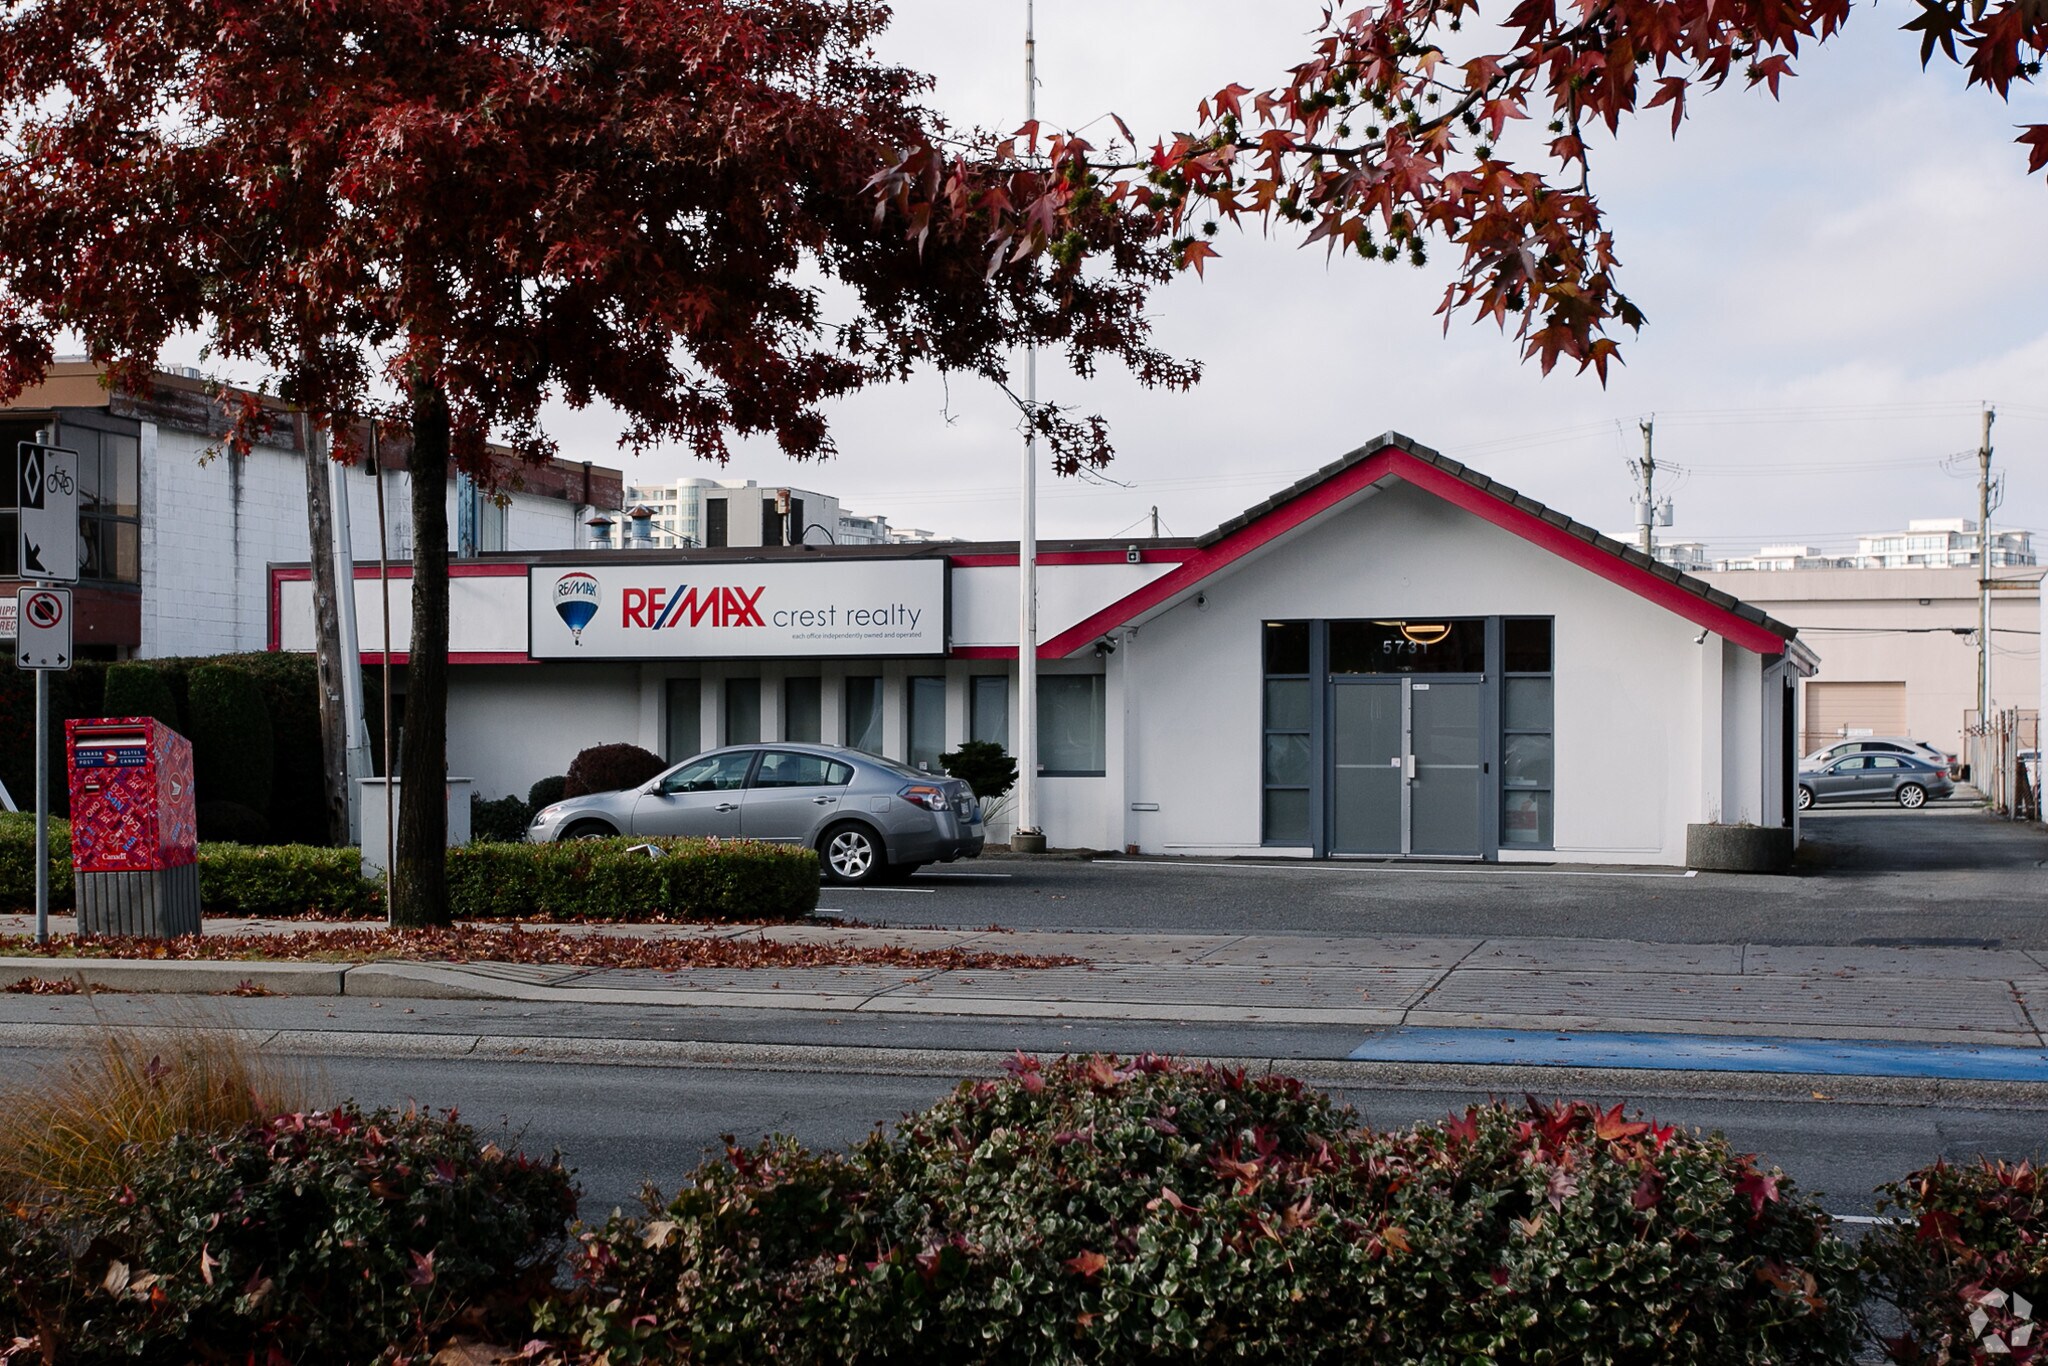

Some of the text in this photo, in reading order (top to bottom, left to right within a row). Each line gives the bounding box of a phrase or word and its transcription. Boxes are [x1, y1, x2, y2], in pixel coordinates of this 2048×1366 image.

[558, 580, 597, 597] RE/MAX
[622, 584, 922, 631] RE/MAX crest realty
[823, 632, 863, 640] independently
[884, 631, 895, 639] and
[896, 631, 922, 640] operated
[1383, 640, 1427, 654] 5731
